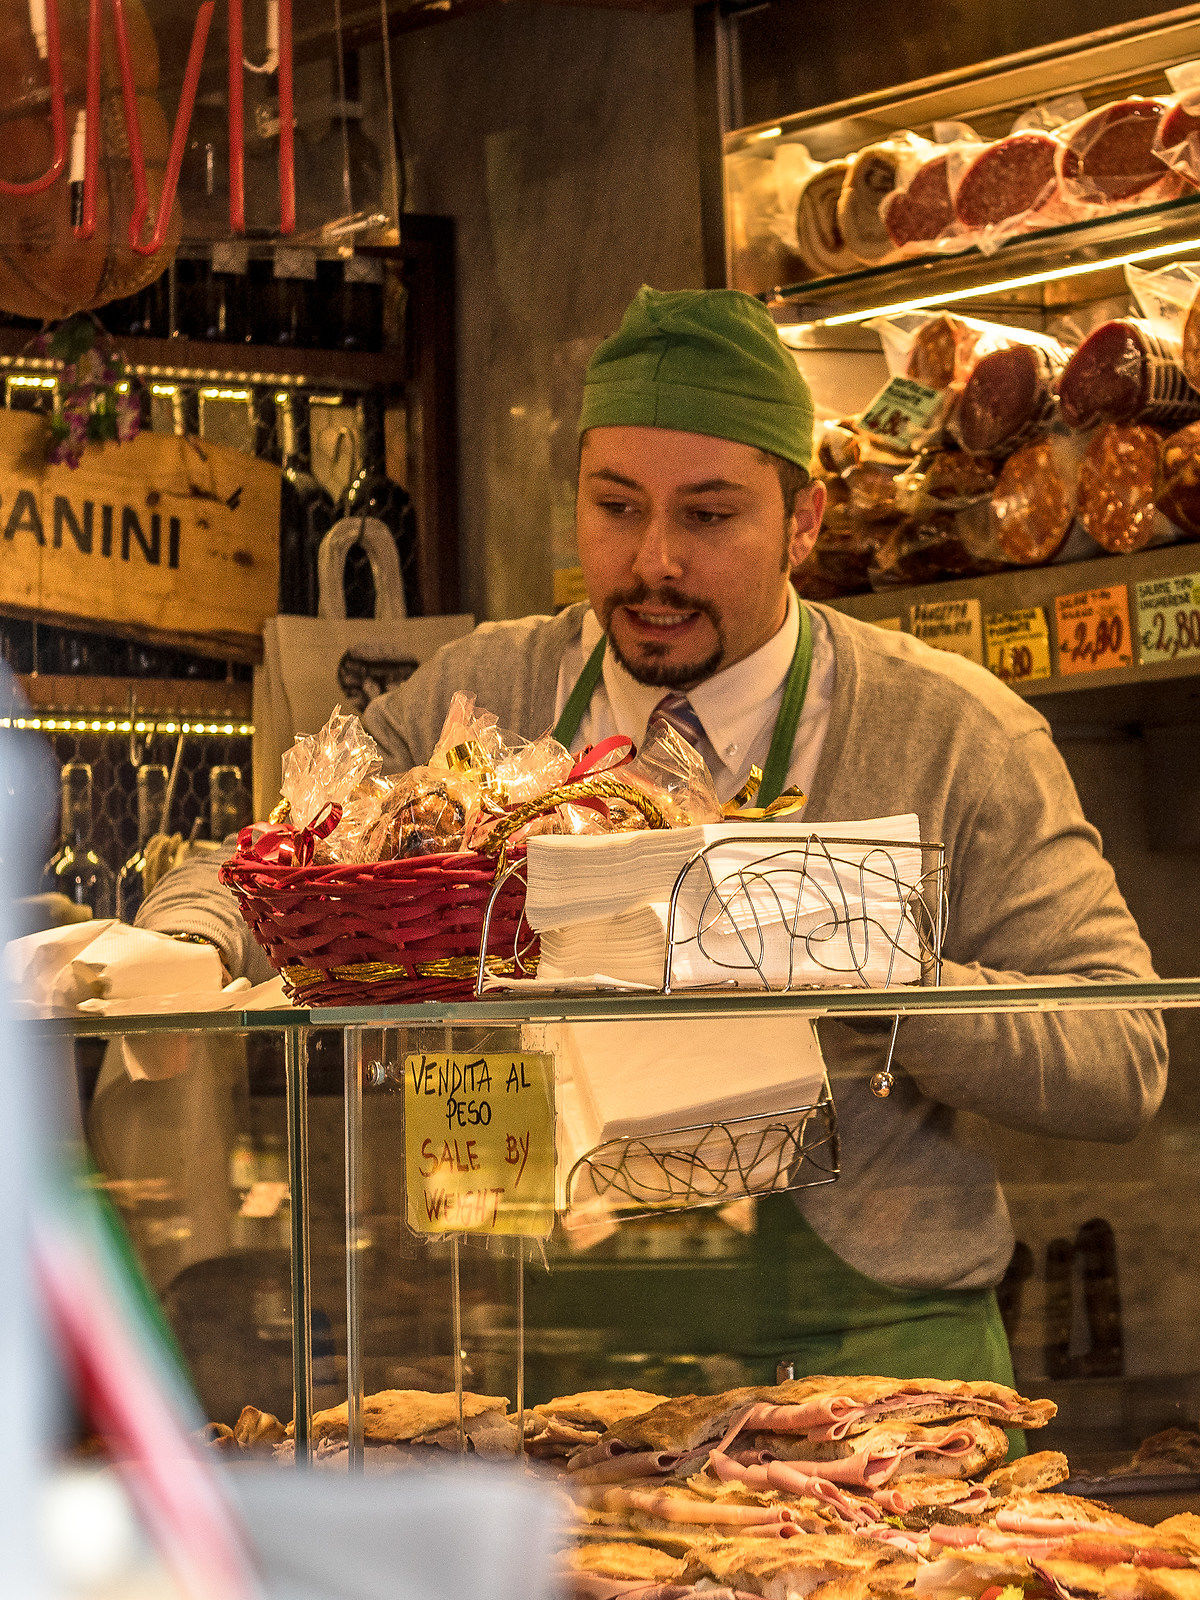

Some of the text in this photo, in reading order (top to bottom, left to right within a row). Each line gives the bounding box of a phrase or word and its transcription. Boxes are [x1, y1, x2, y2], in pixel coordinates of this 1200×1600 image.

[0, 488, 181, 570] ANINI
[411, 1056, 531, 1098] VENDITA AL
[446, 1097, 492, 1130] PESO
[419, 1138, 480, 1178] SALE
[424, 1187, 505, 1228] WEIGHT
